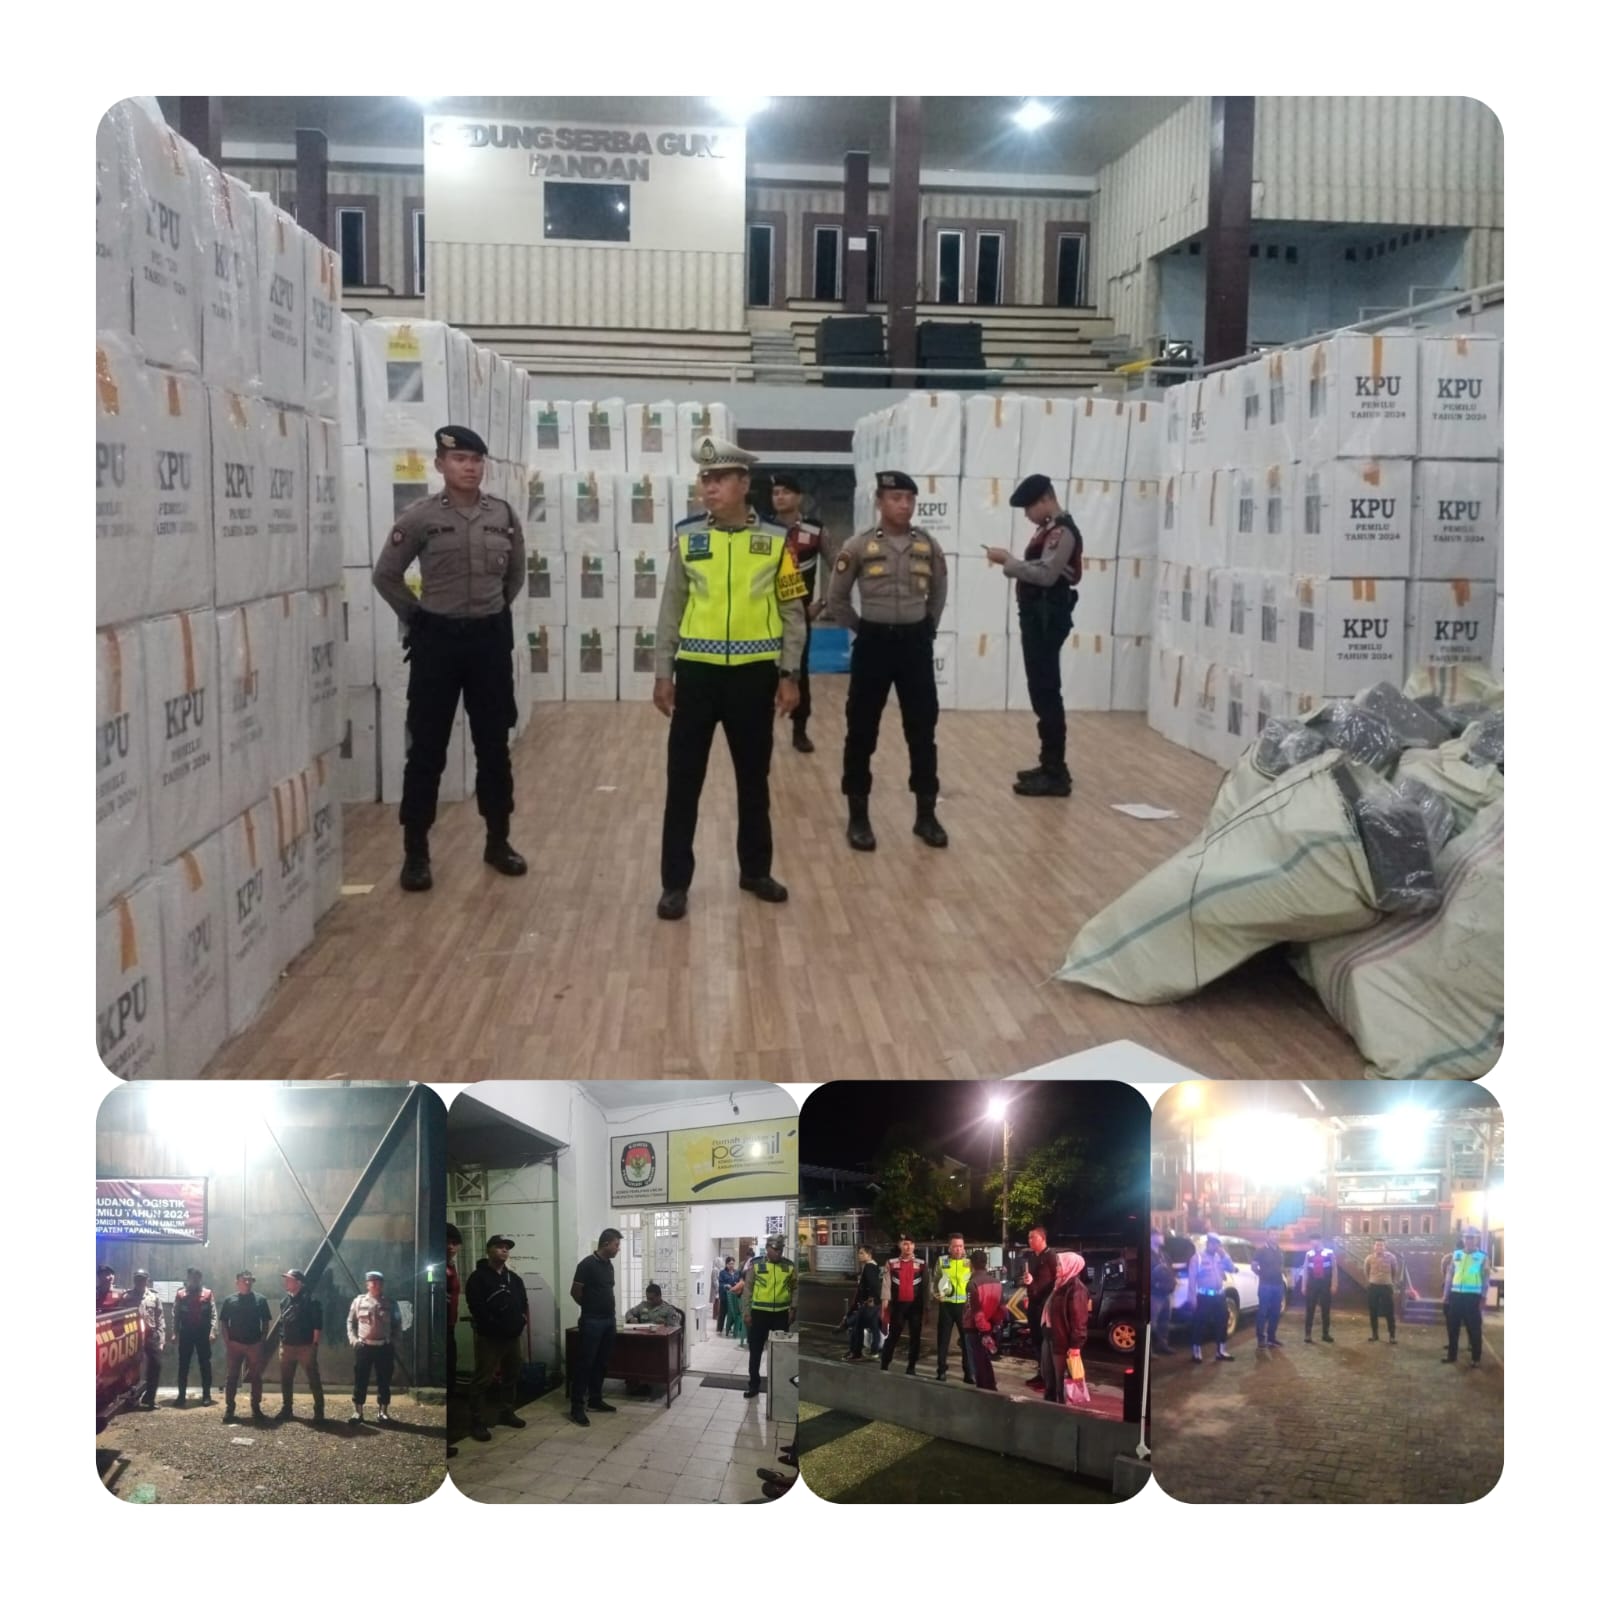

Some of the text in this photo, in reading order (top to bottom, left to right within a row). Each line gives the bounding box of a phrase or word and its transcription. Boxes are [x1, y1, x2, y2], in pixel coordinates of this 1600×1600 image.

[555, 128, 653, 155] SERBA
[529, 153, 650, 181] PANDAN
[1355, 375, 1401, 396] KPU
[1437, 378, 1482, 399] KPU
[225, 462, 254, 498] KPU
[918, 503, 947, 516] KPU
[1350, 499, 1396, 519] KPU
[1438, 501, 1481, 520] KPU
[1378, 533, 1400, 541] 2024
[1343, 619, 1389, 638] KPU
[1434, 620, 1479, 641] KPU
[165, 688, 205, 740] KPU
[97, 976, 147, 1054] KPU
[124, 1209, 161, 1218] TAHUN
[163, 1210, 190, 1219] 2024
[137, 1199, 185, 1208] LOGISTIK
[98, 1332, 139, 1370] POLISI
